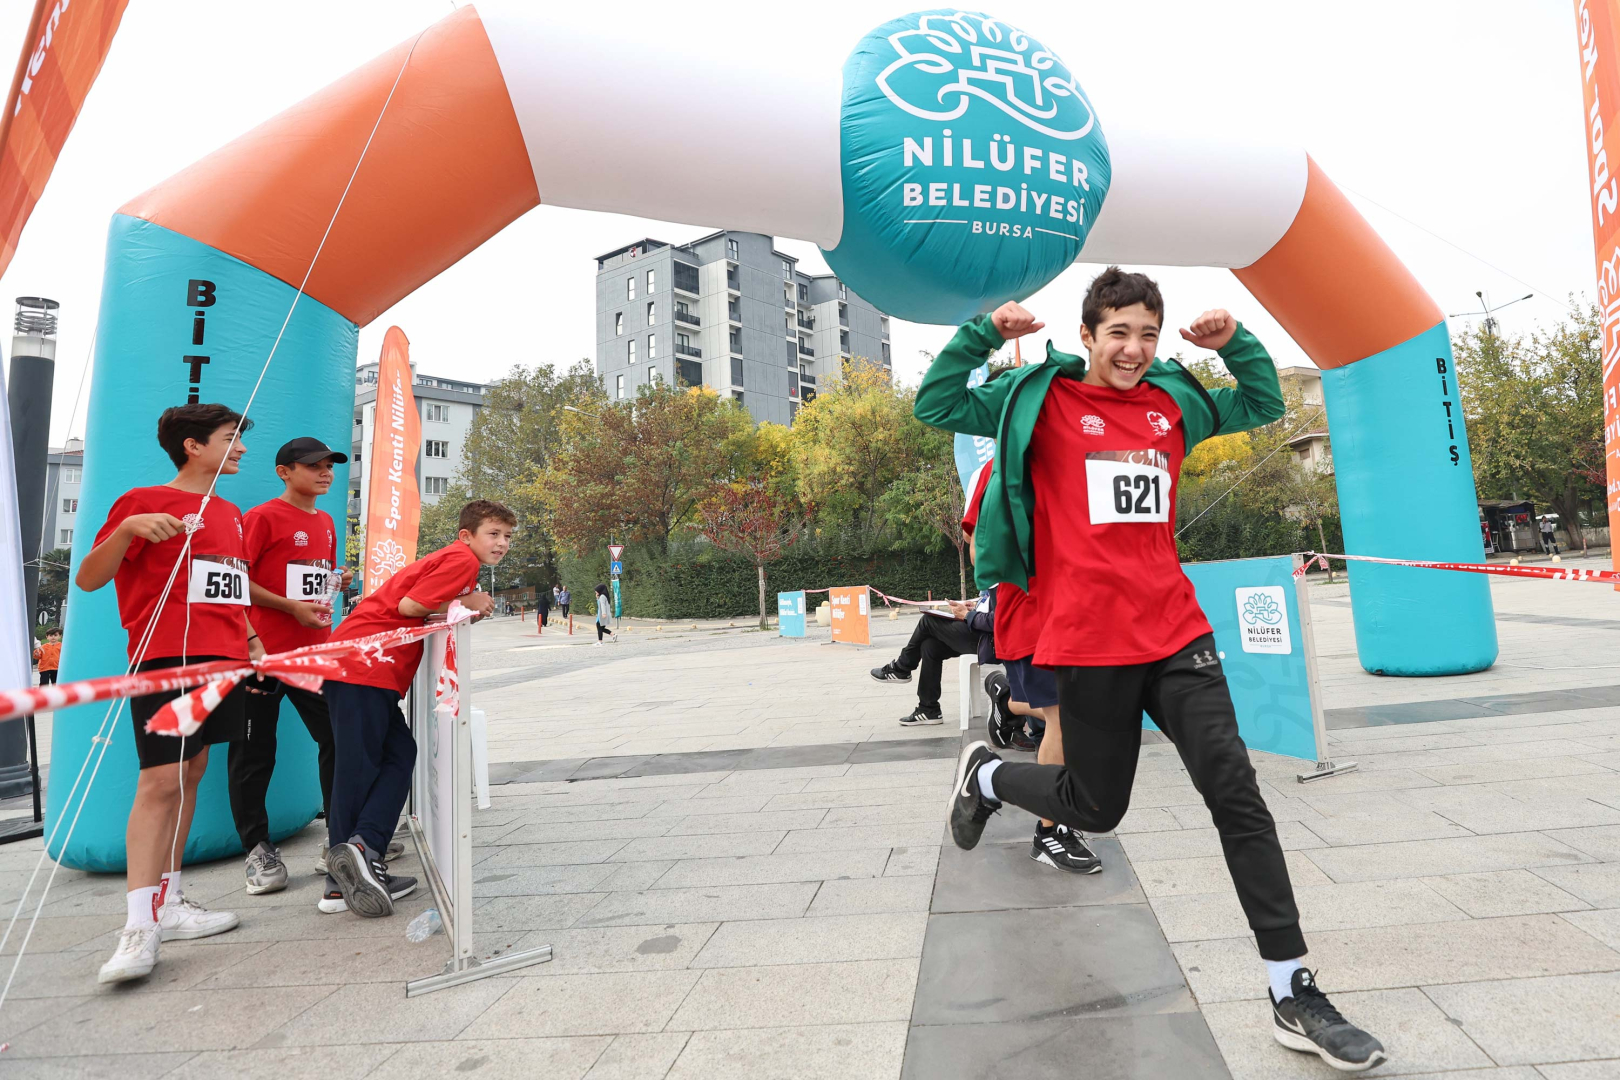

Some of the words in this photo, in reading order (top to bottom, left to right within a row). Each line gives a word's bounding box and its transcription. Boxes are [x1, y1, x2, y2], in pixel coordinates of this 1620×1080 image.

[903, 128, 1090, 191] NİLÜFER
[903, 182, 1085, 226] BELEDİYESİ
[971, 220, 1033, 239] BURSA
[182, 279, 217, 404] BİTİ
[1436, 358, 1459, 466] BİTİŞ
[388, 433, 405, 482] Kenti
[384, 485, 402, 530] Spor
[1113, 474, 1161, 514] 621
[204, 572, 242, 599] 530
[1247, 626, 1282, 635] NİLÜFER
